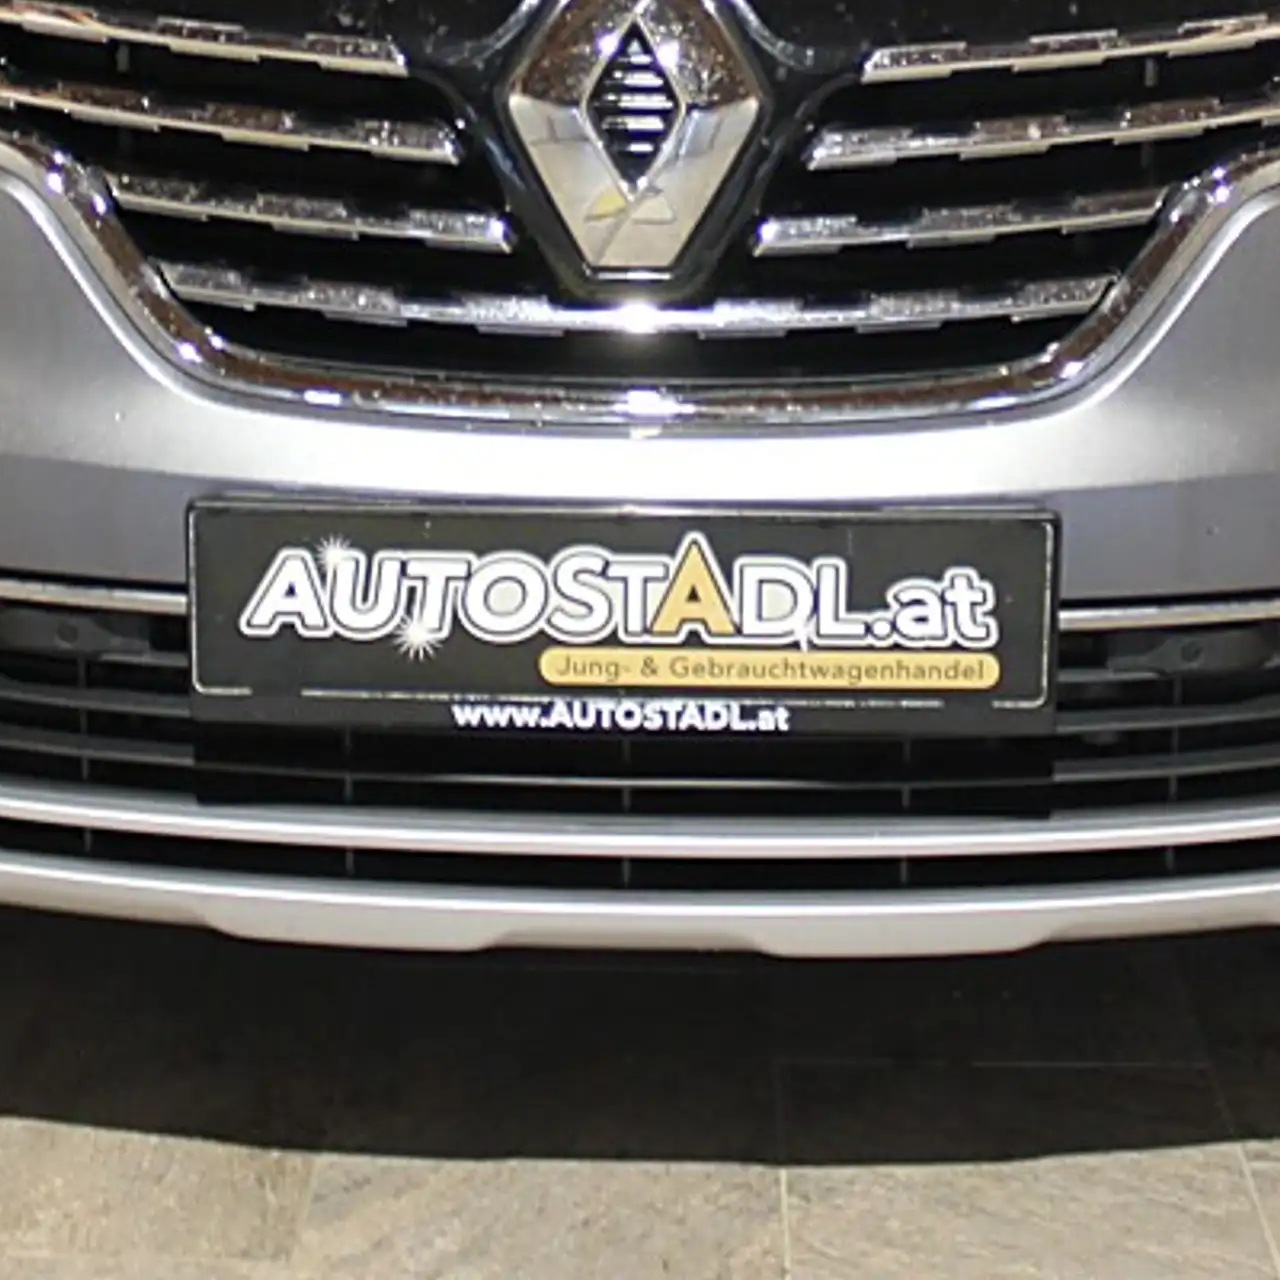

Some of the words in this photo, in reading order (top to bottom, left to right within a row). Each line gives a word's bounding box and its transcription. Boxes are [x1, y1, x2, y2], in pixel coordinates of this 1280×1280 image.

[241, 532, 998, 647] AUTOSTADL.at
[555, 654, 631, 683] Jung-
[640, 655, 659, 679] &
[669, 656, 985, 685] Gebrauchtwagenhandel
[451, 700, 790, 732] www.AUTOSTADL.at
